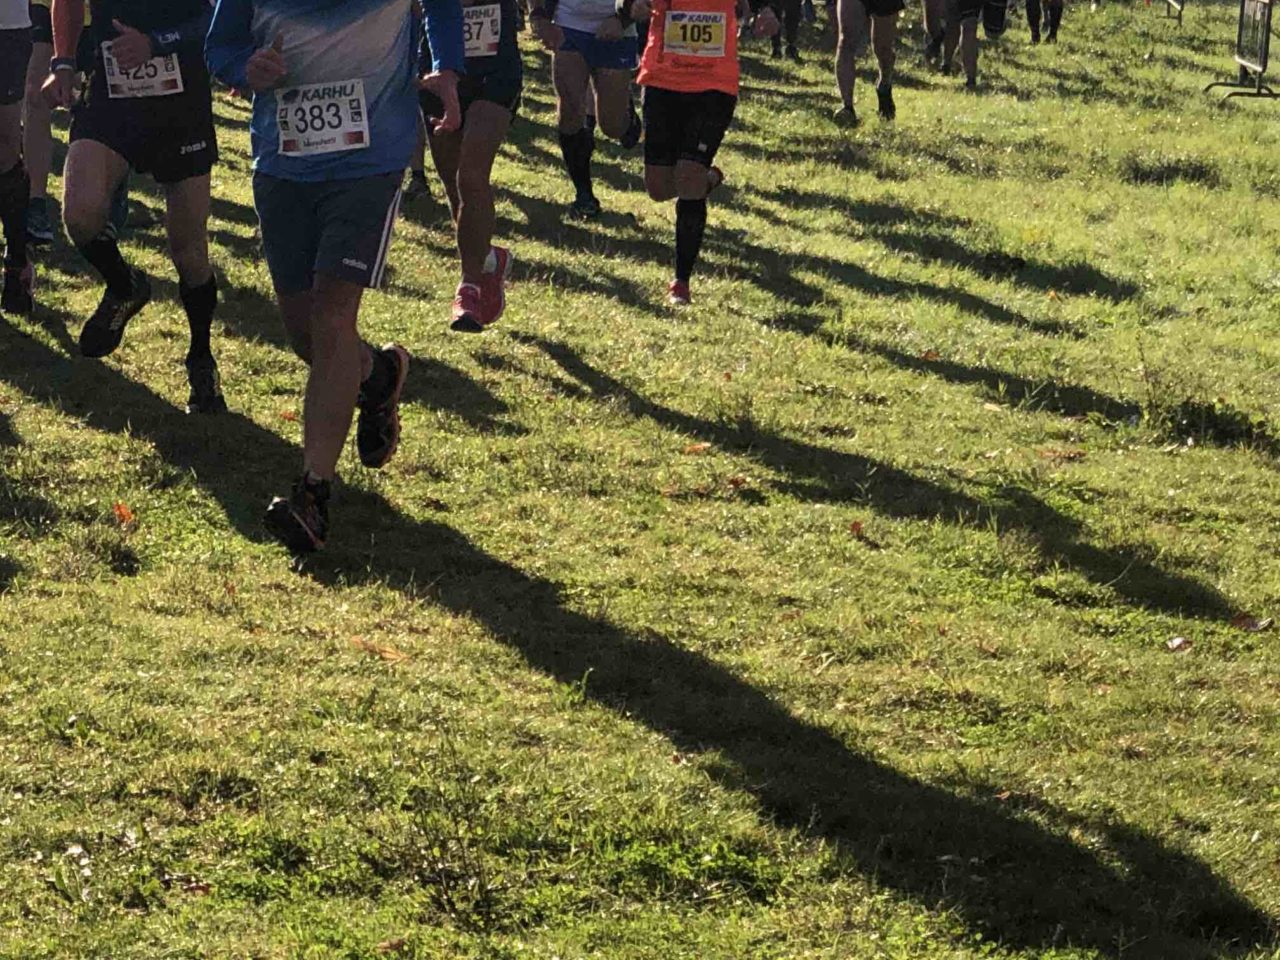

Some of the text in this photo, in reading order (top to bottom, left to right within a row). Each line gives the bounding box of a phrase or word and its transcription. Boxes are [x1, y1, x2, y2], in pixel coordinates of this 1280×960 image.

[464, 7, 496, 20] ARHU
[688, 15, 723, 23] KARHU
[463, 21, 484, 42] 87
[680, 24, 713, 43] 105
[301, 84, 355, 103] KARHU
[294, 102, 343, 134] 383
